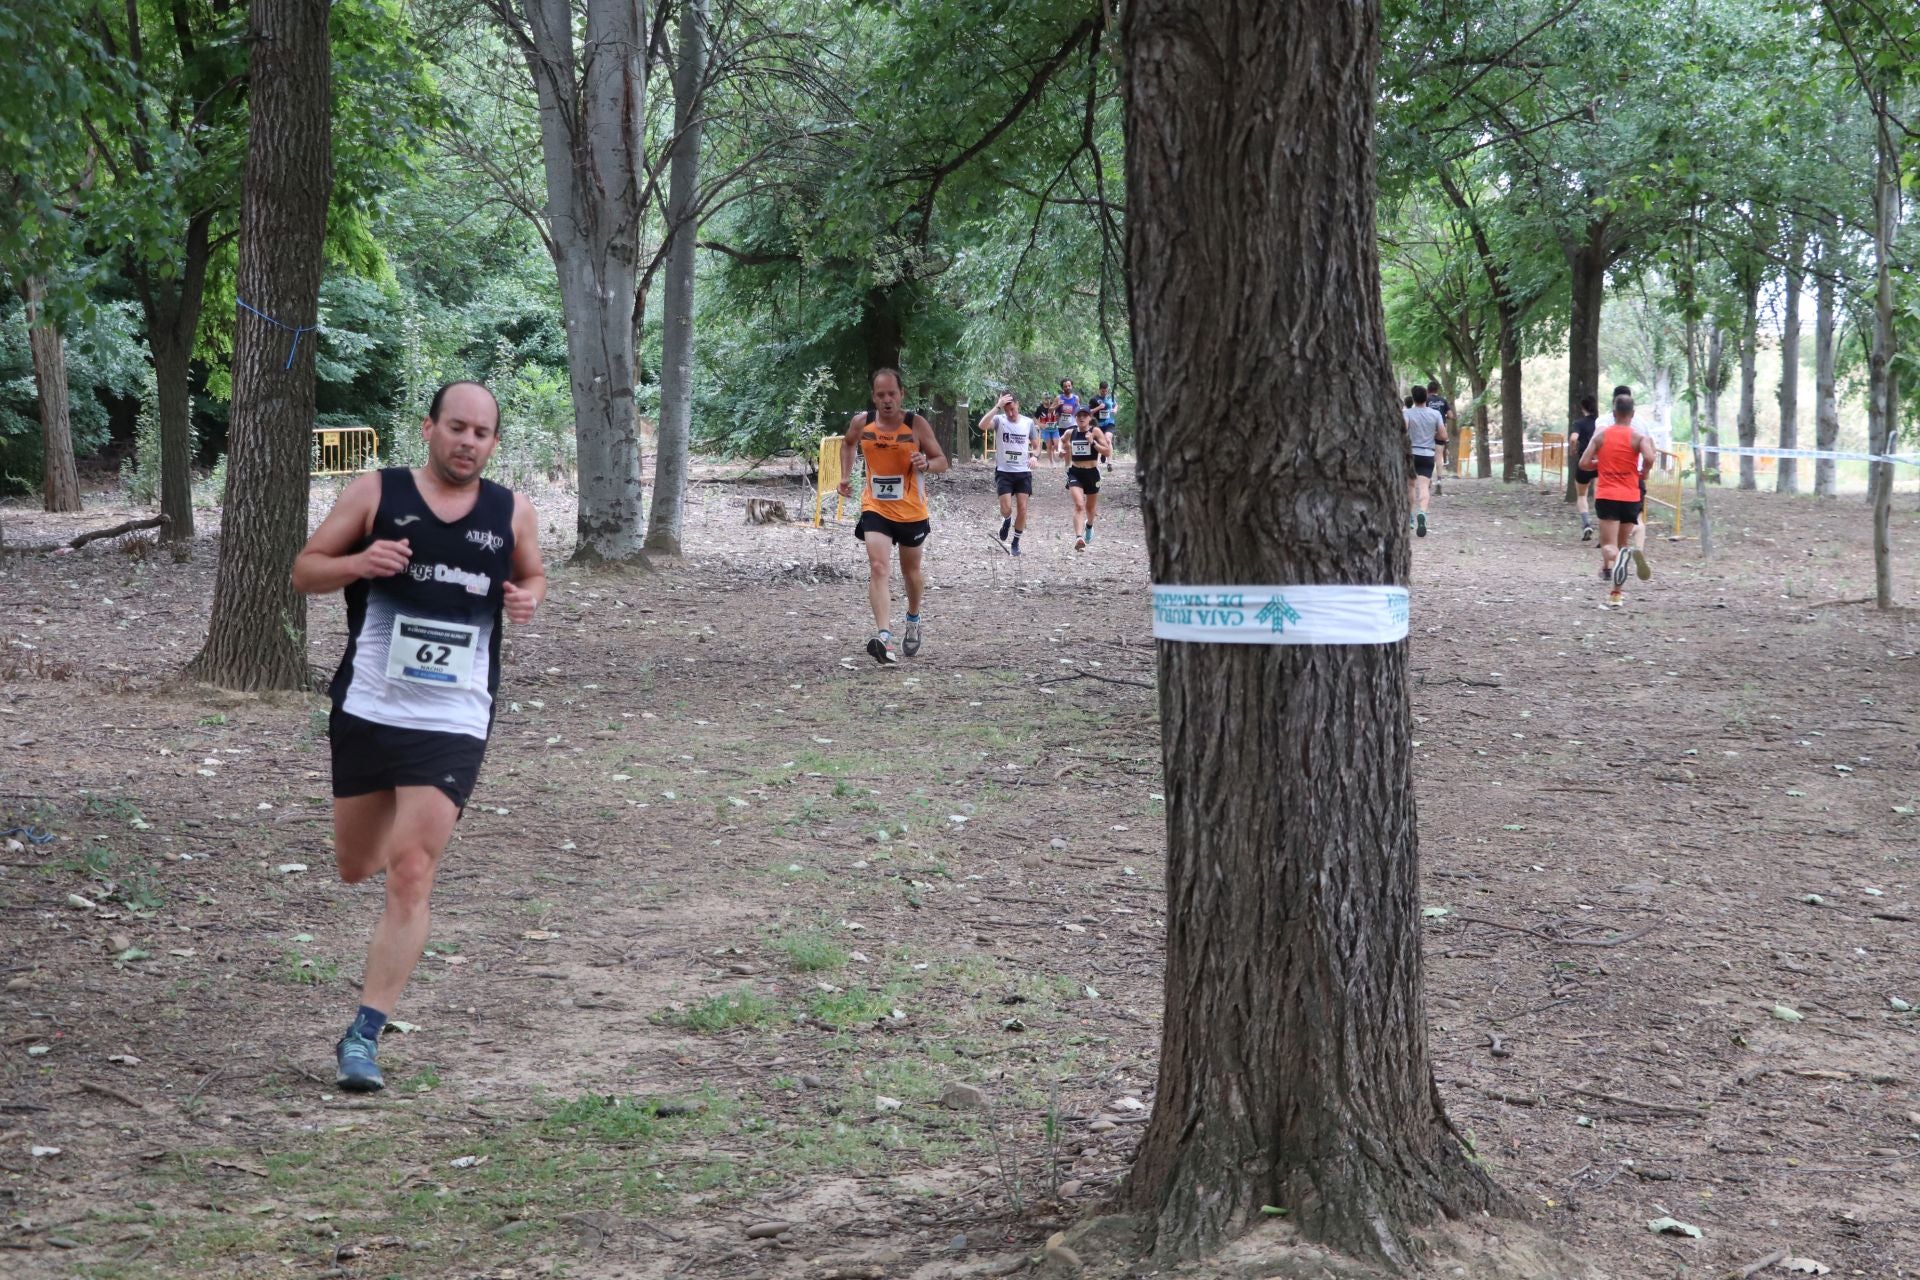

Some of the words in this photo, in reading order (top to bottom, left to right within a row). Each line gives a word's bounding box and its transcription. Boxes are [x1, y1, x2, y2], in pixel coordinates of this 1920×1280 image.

[879, 484, 894, 493] 74
[1216, 594, 1244, 608] DE
[1197, 609, 1244, 627] CAJA
[416, 644, 452, 666] 62
[420, 665, 444, 673] NACHO
